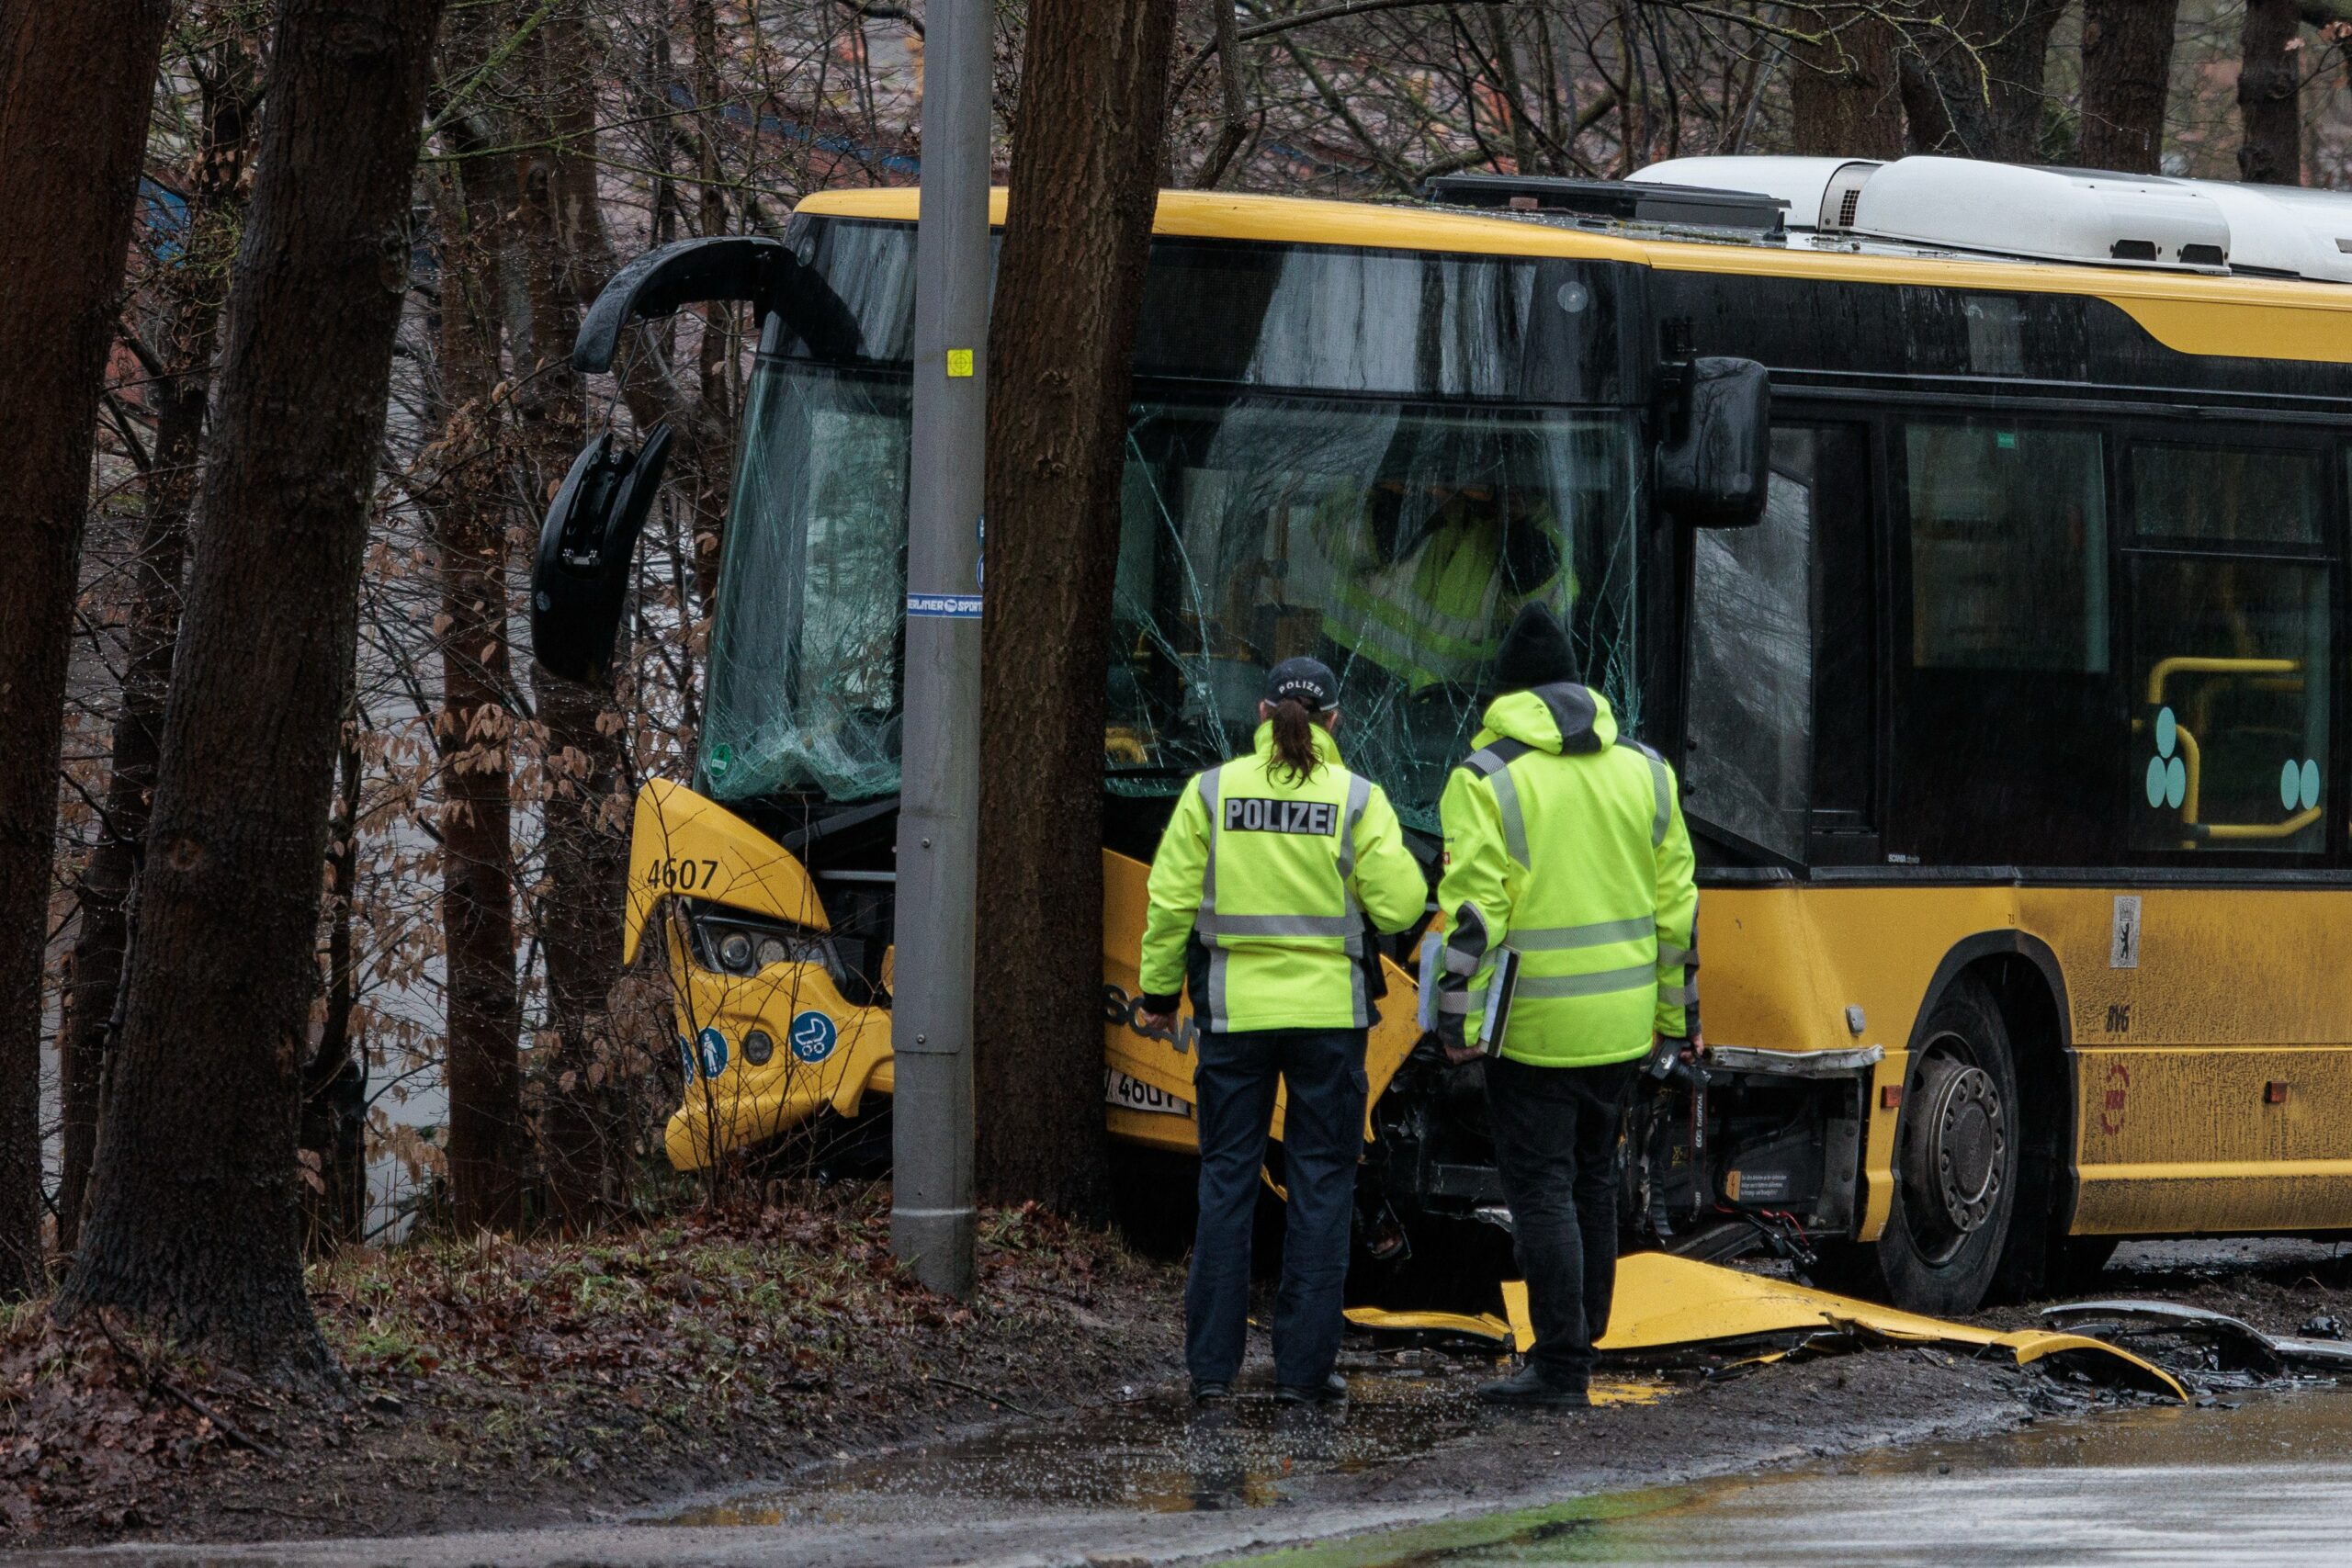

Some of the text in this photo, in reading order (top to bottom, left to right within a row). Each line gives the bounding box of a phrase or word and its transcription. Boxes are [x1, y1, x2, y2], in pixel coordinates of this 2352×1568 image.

[1278, 680, 1324, 697] POLIZEI
[1225, 798, 1338, 837] POLIZEI
[647, 857, 718, 890] 4607
[2106, 1004, 2131, 1033] BVG
